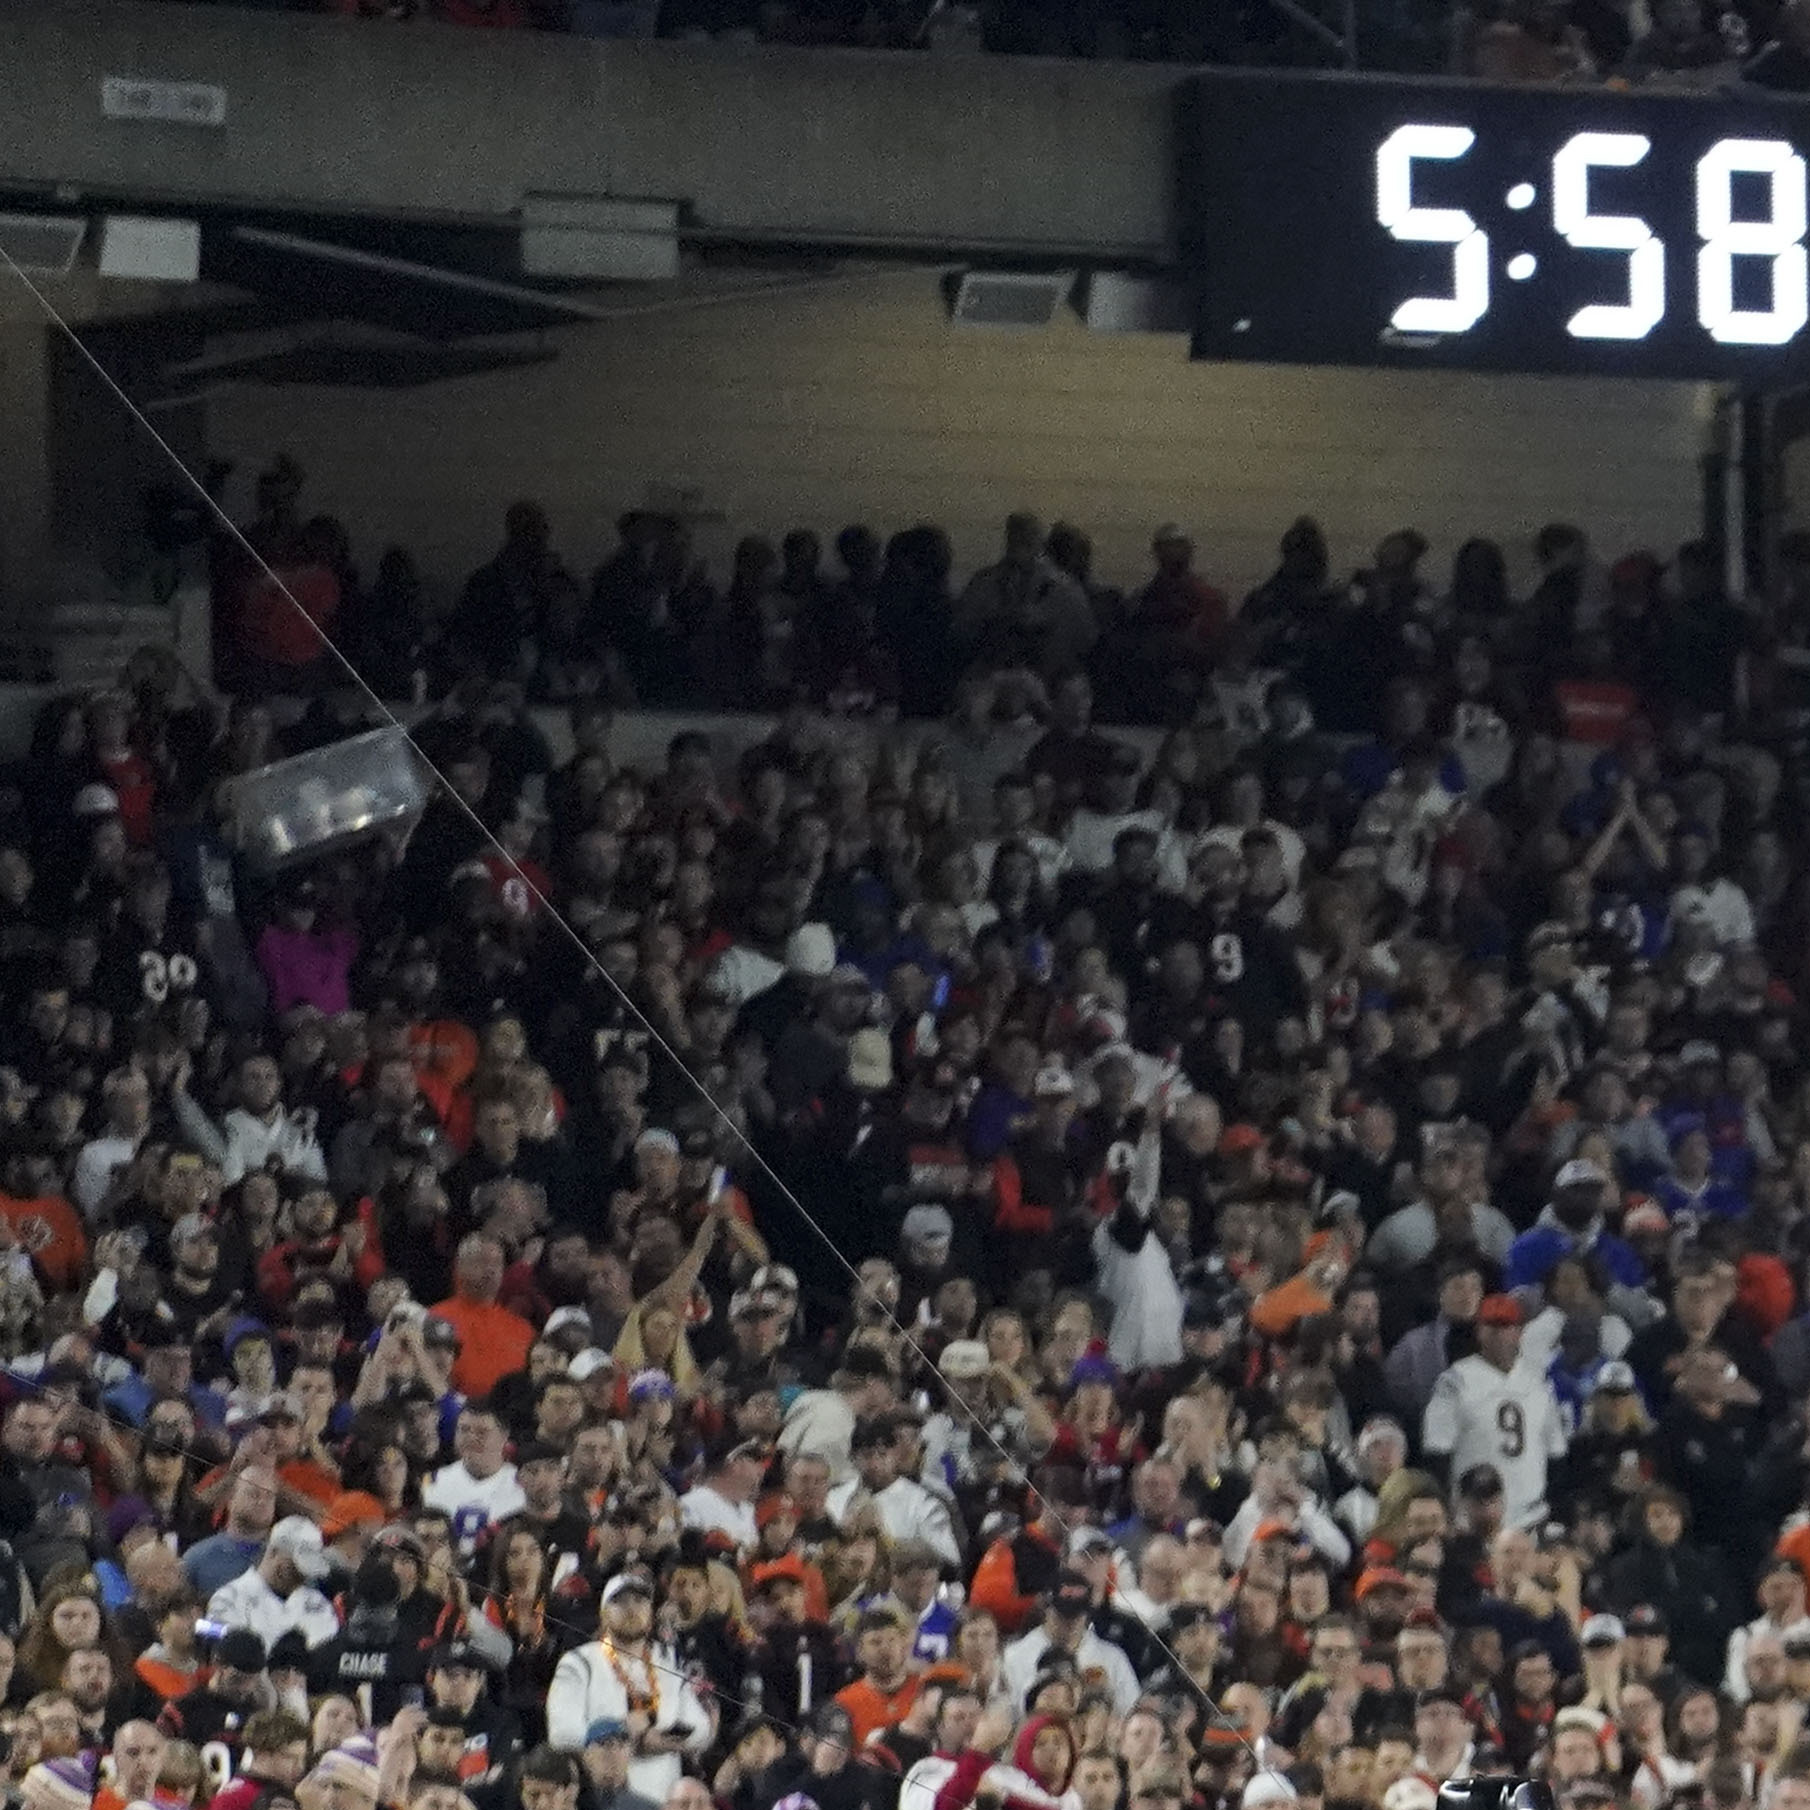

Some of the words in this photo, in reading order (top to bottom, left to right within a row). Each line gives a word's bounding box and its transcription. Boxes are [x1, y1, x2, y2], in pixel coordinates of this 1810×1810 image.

[1377, 124, 1809, 344] 5:58
[1212, 933, 1244, 983] 9
[1496, 1399, 1527, 1459] 9
[338, 1649, 389, 1680] CHASE
[798, 1652, 814, 1715] 1
